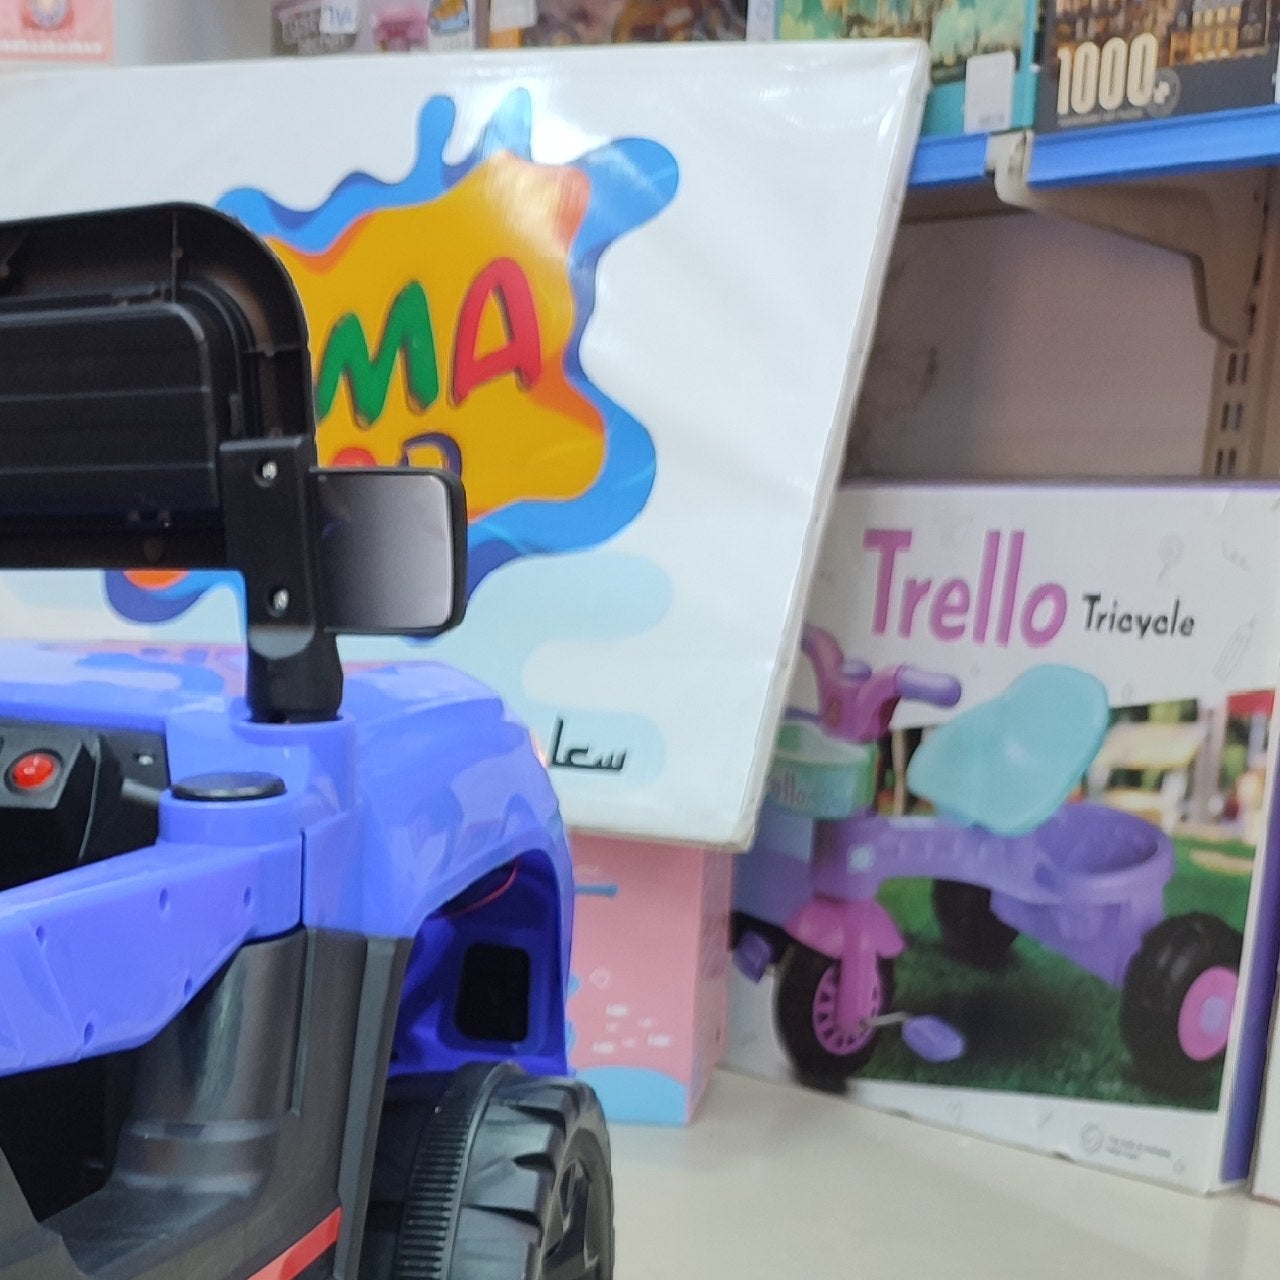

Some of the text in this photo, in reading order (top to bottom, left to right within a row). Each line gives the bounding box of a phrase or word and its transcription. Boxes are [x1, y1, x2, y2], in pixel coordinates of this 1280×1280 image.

[316, 255, 541, 428] MA
[863, 528, 1195, 648] Trello Tricycle
[549, 716, 627, 771] سعا
